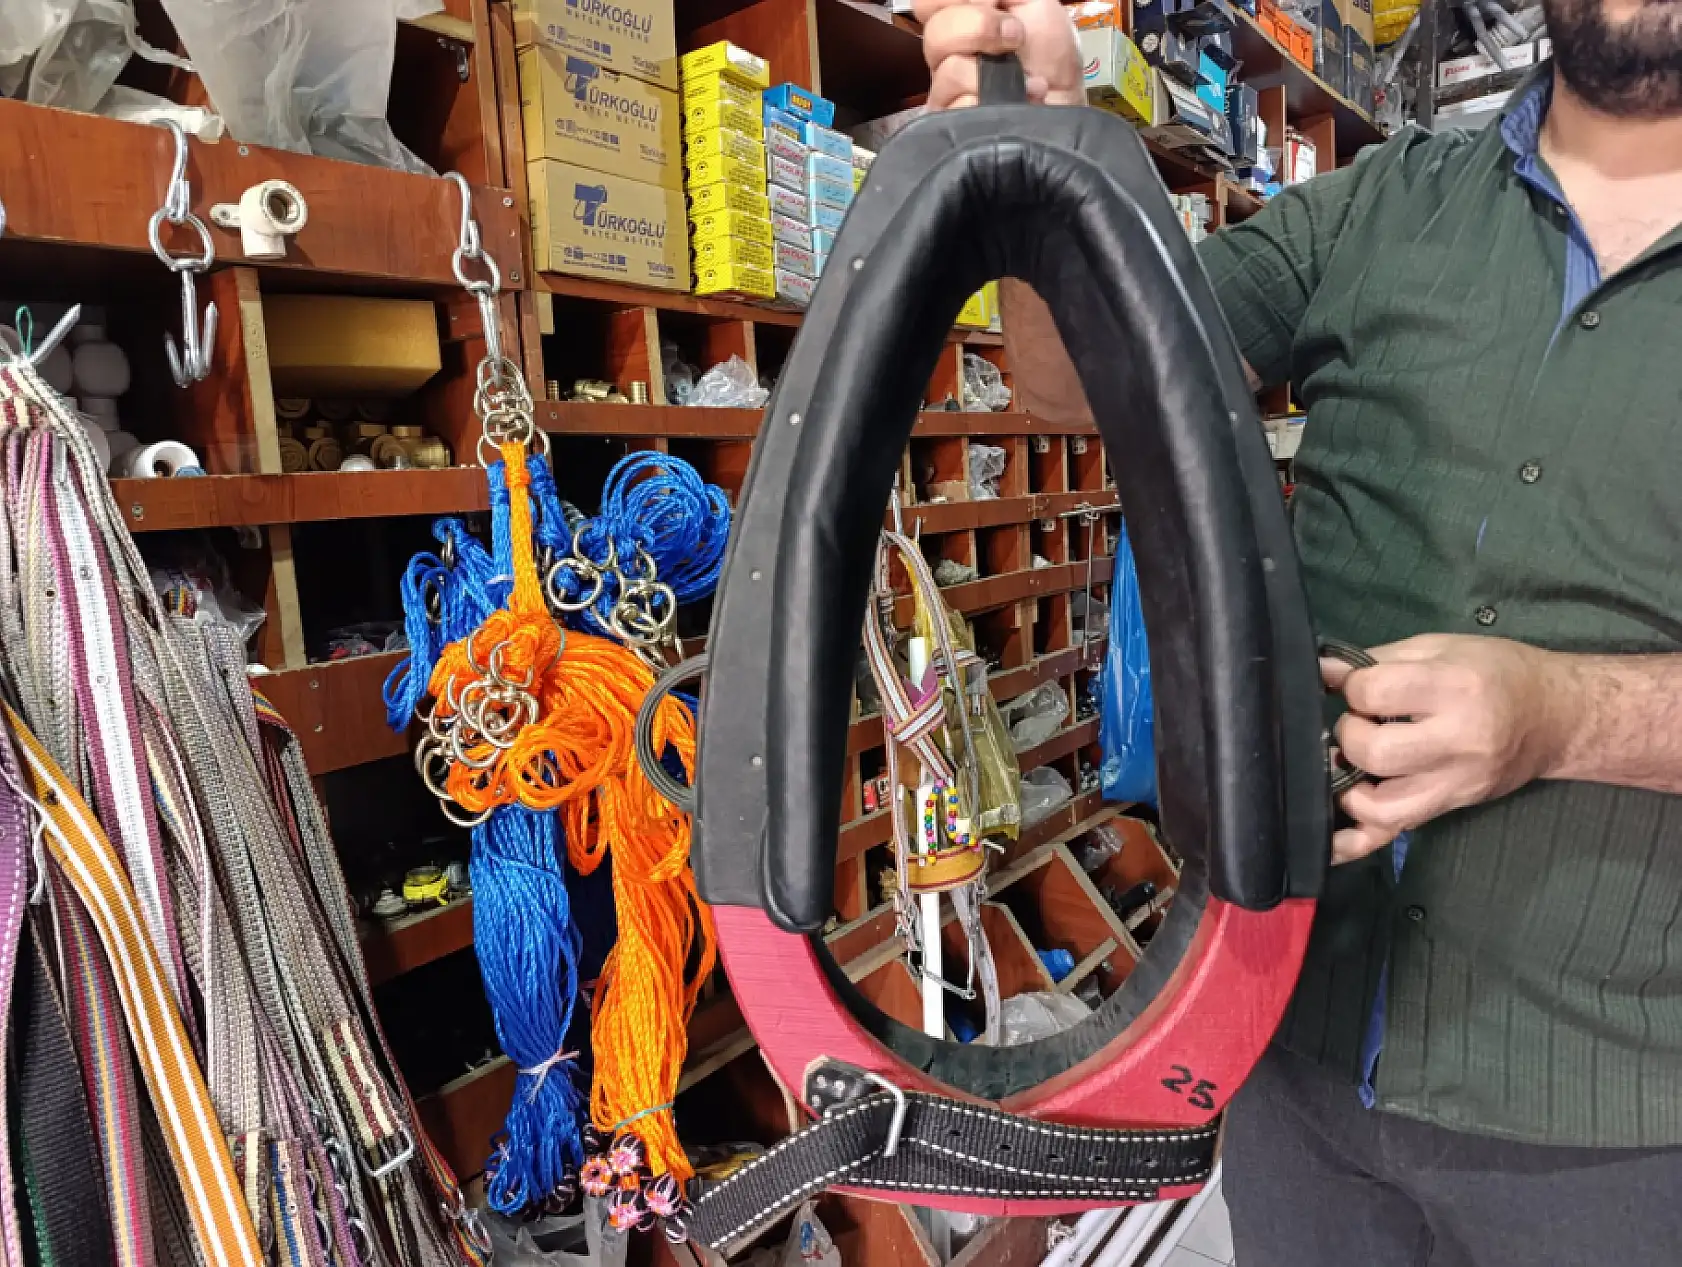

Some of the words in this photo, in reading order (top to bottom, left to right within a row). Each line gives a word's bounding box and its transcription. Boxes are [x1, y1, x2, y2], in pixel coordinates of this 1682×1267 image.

[565, 55, 658, 122] TÜRKOĞLU
[574, 183, 665, 239] TÜRKOĞLU
[1161, 1064, 1218, 1110] 25
